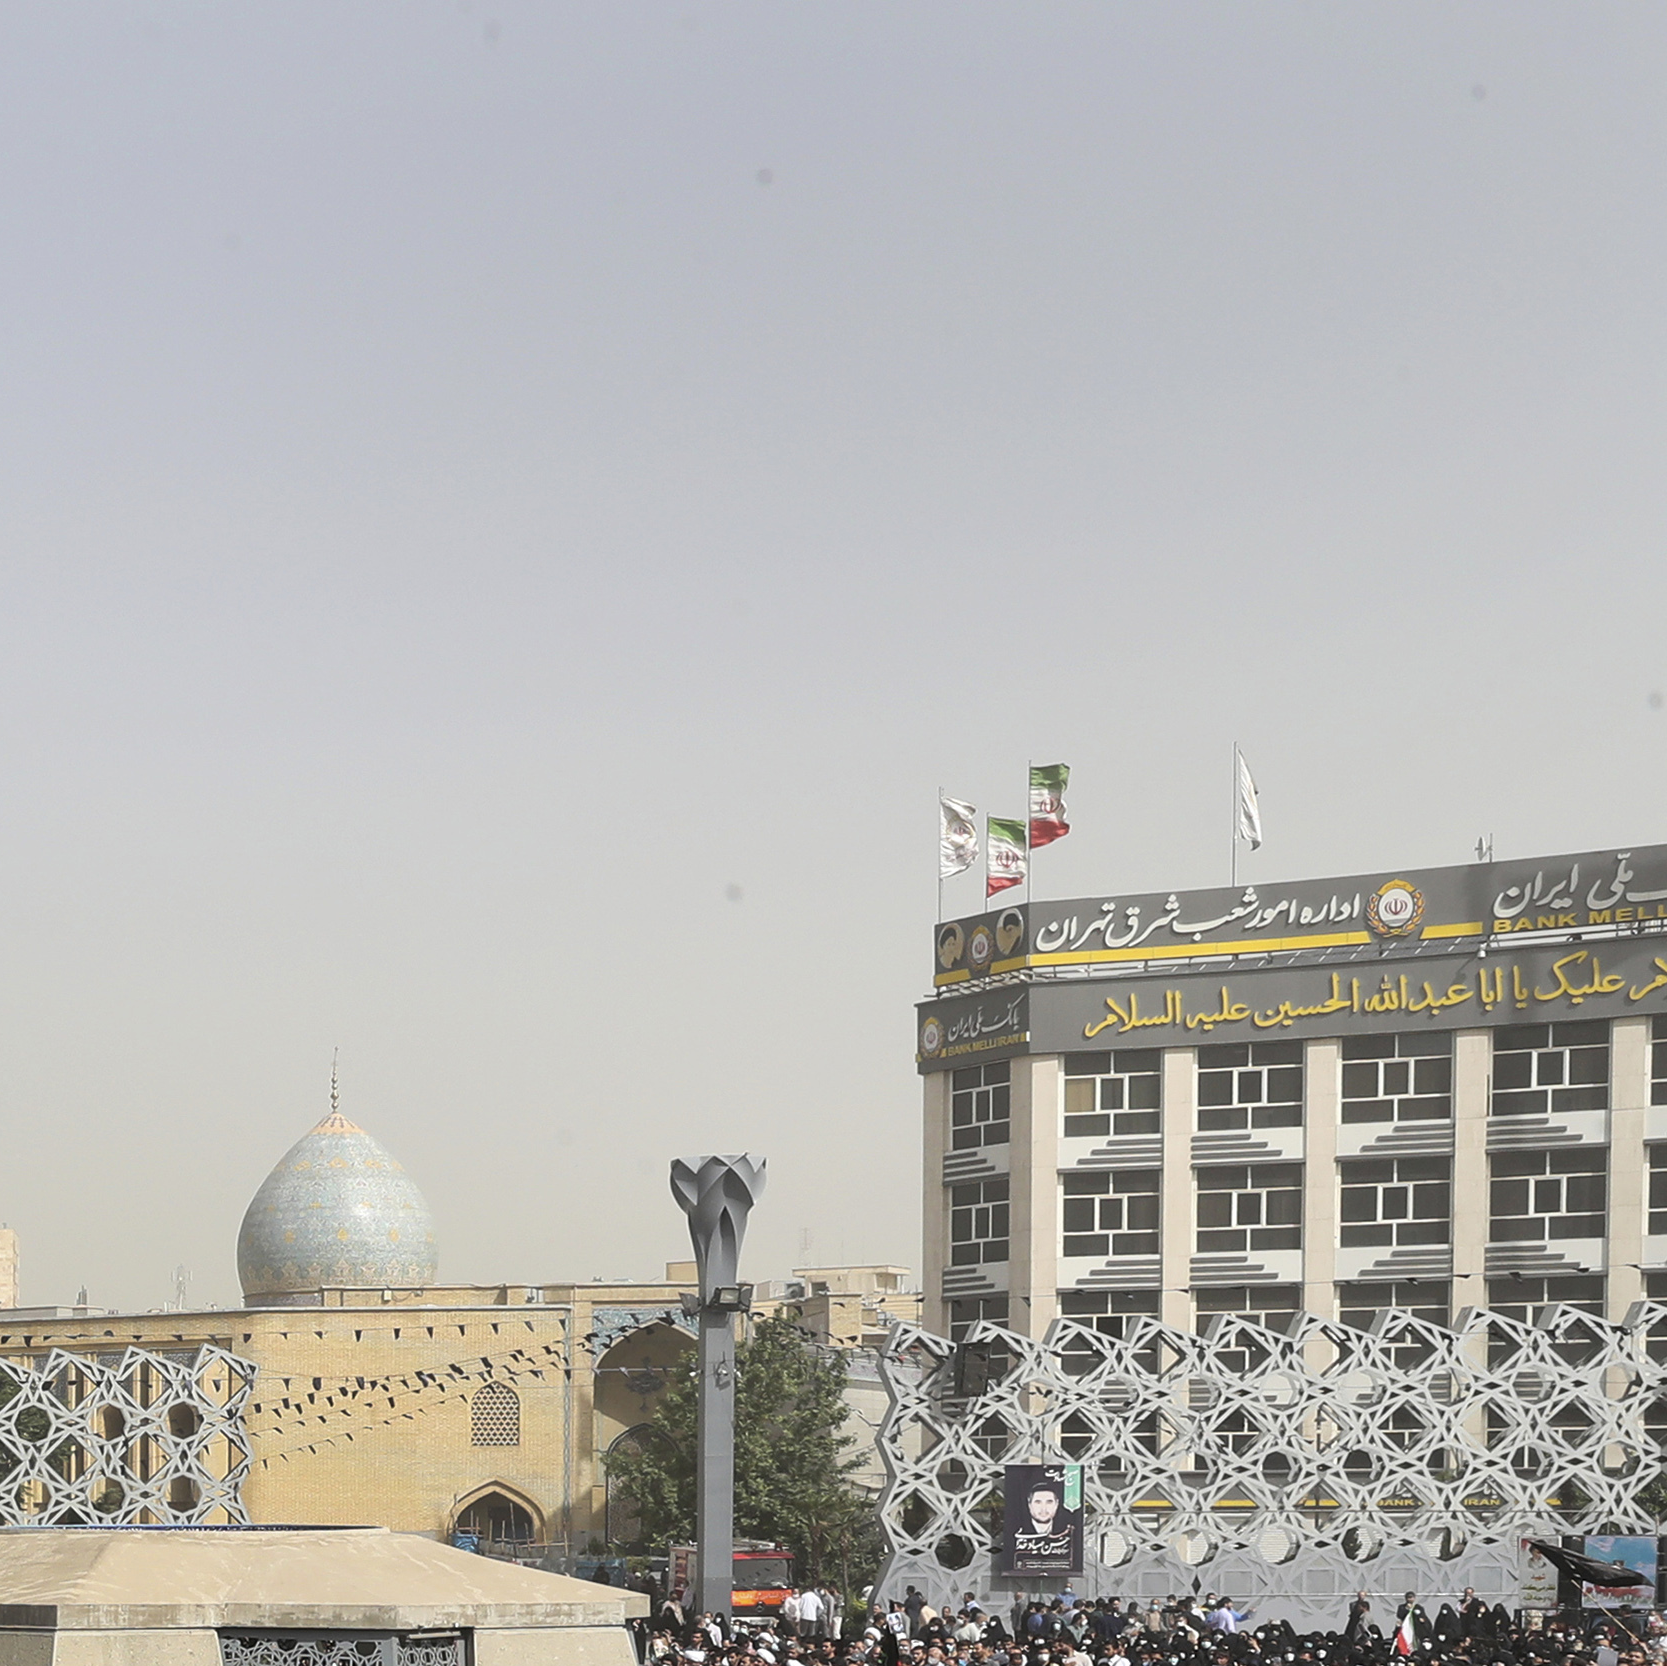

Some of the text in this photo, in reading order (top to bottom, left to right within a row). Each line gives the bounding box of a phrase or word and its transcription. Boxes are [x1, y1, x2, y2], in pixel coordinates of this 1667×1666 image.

[1493, 862, 1580, 919] ایران
[1035, 887, 1361, 952] اداره امور شعب شرق تهران
[1493, 912, 1578, 933] BANK
[1254, 971, 1359, 1028] الحسین
[1513, 965, 1529, 1009] یا
[1534, 951, 1626, 1004] علیک
[1084, 989, 1182, 1039] السلام
[1185, 986, 1252, 1034] علیه
[948, 1045, 971, 1056] BANK
[1464, 1498, 1500, 1506] IRAN
